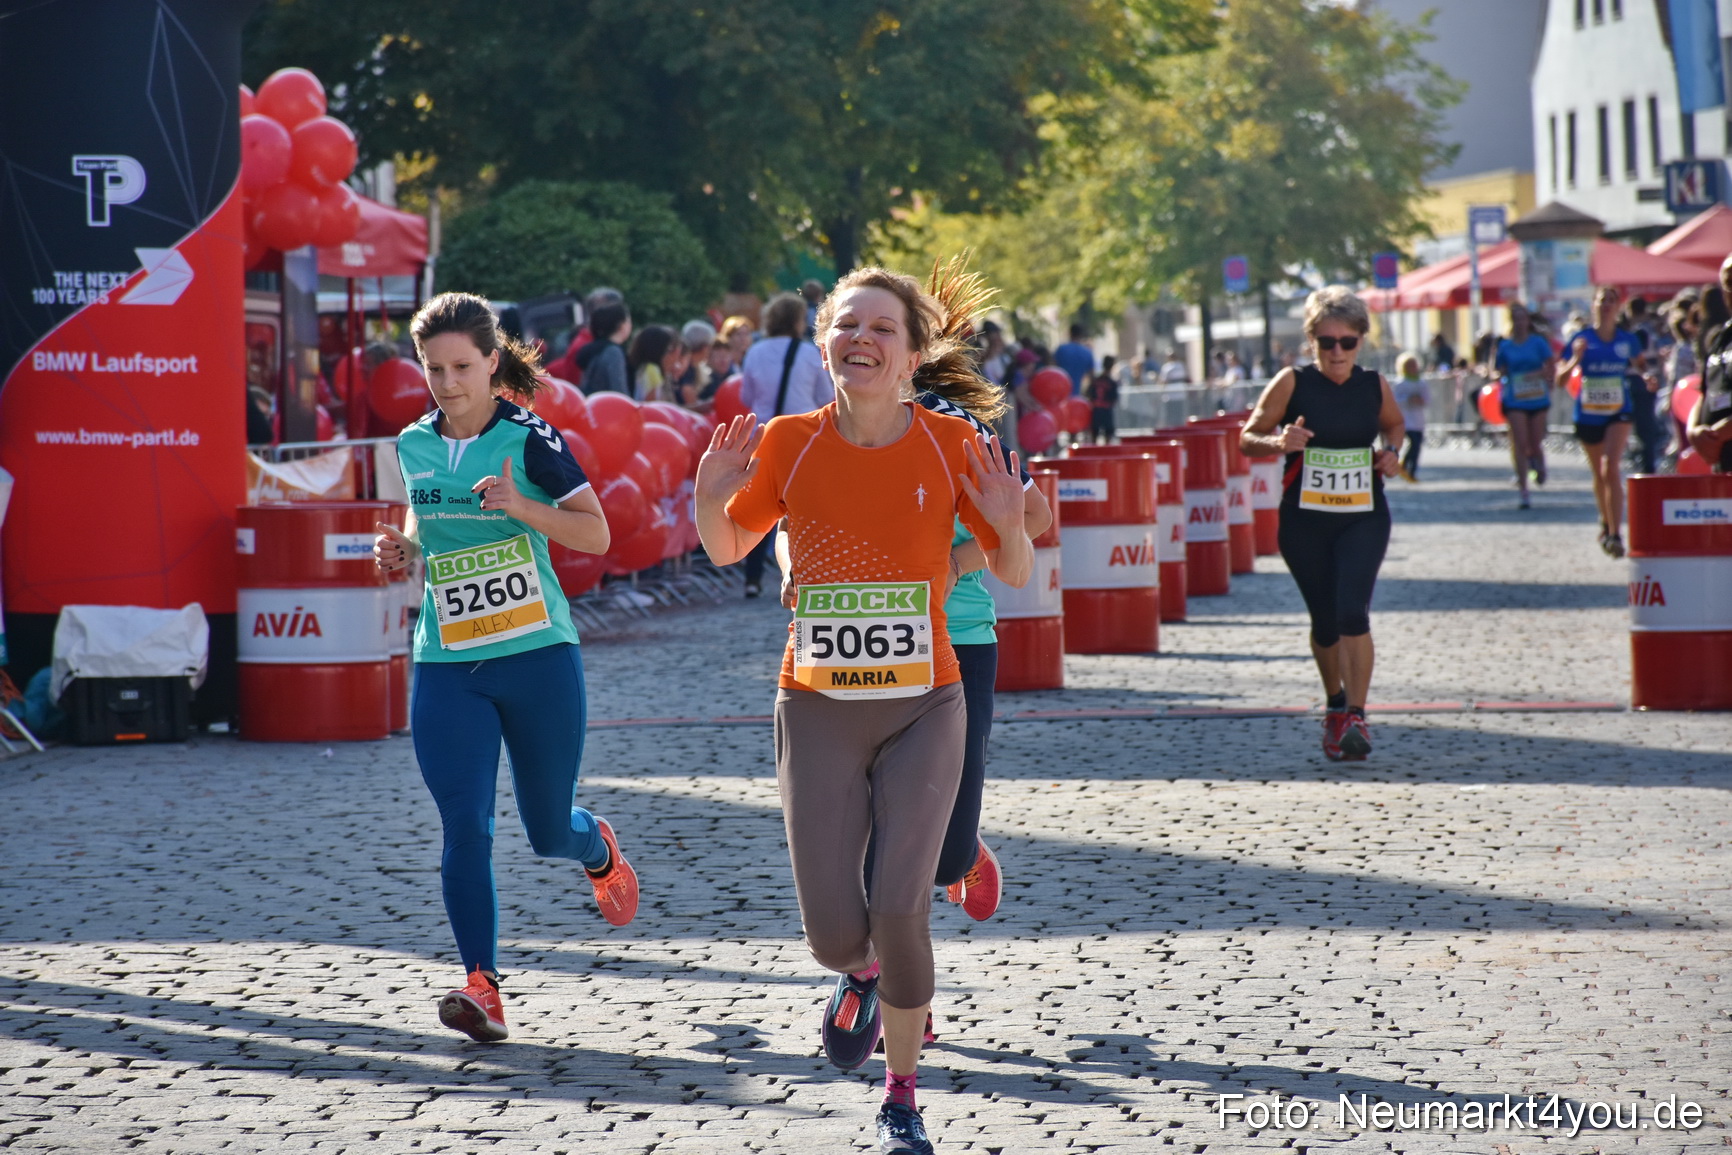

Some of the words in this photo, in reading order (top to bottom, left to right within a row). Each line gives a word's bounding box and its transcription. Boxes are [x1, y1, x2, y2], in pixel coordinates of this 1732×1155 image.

[54, 271, 82, 288] THE
[86, 272, 128, 288] NEXT
[33, 288, 54, 304] 100
[57, 288, 110, 305] YEARS
[33, 351, 87, 371] BMW
[92, 352, 198, 377] Laufsport
[35, 428, 200, 448] www.bmw-partl.de
[1310, 452, 1364, 466] BOCK
[408, 468, 435, 481] ummel
[1311, 470, 1362, 490] 5111
[447, 496, 472, 505] GmbH
[1321, 495, 1353, 505] LYDIA
[422, 512, 437, 520] und
[436, 542, 522, 580] BOCK
[445, 572, 528, 616] 5260
[806, 588, 916, 613] BOCK
[252, 606, 323, 638] AVIA
[472, 611, 515, 638] ALEX
[811, 624, 915, 659] 5063
[831, 670, 898, 686] MARIA
